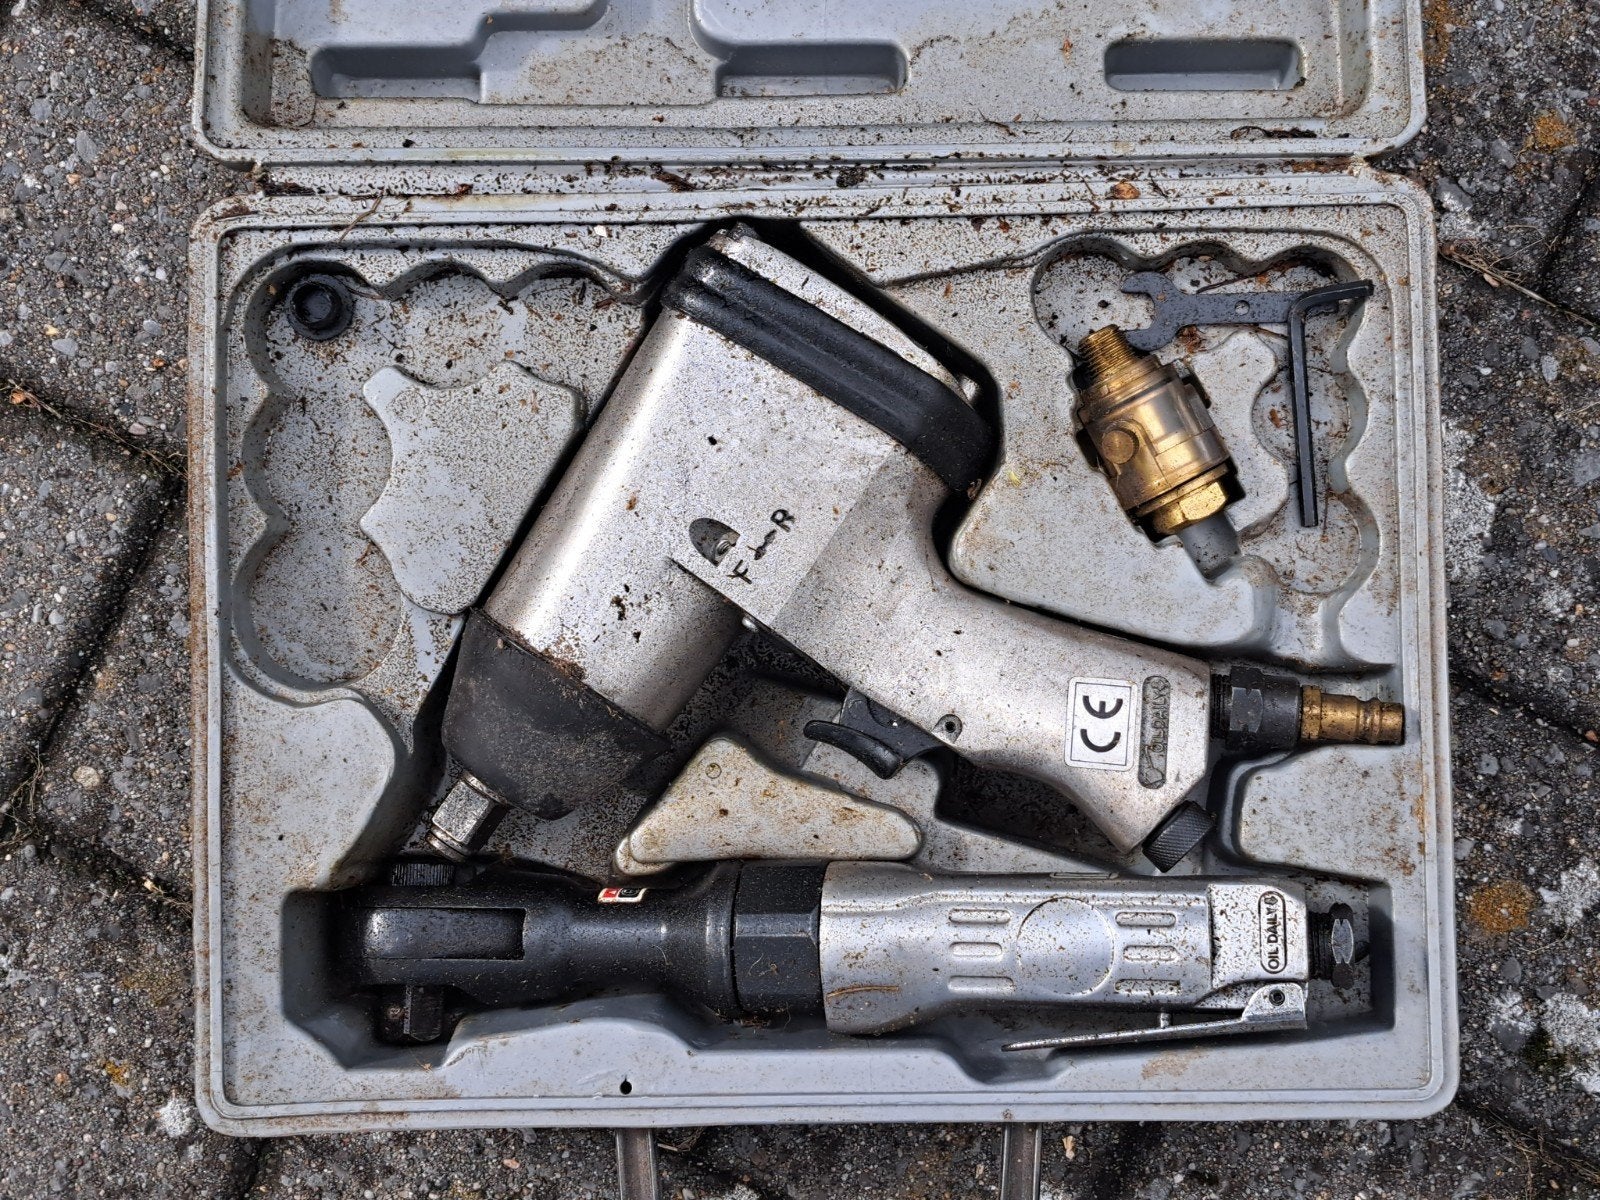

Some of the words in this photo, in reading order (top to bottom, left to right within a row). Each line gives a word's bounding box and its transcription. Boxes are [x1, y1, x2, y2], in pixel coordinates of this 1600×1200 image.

[727, 559, 752, 584] F
[770, 509, 795, 533] R
[1080, 695, 1123, 753] CE
[1266, 907, 1280, 944] DAILY
[1267, 946, 1280, 970] OIL
